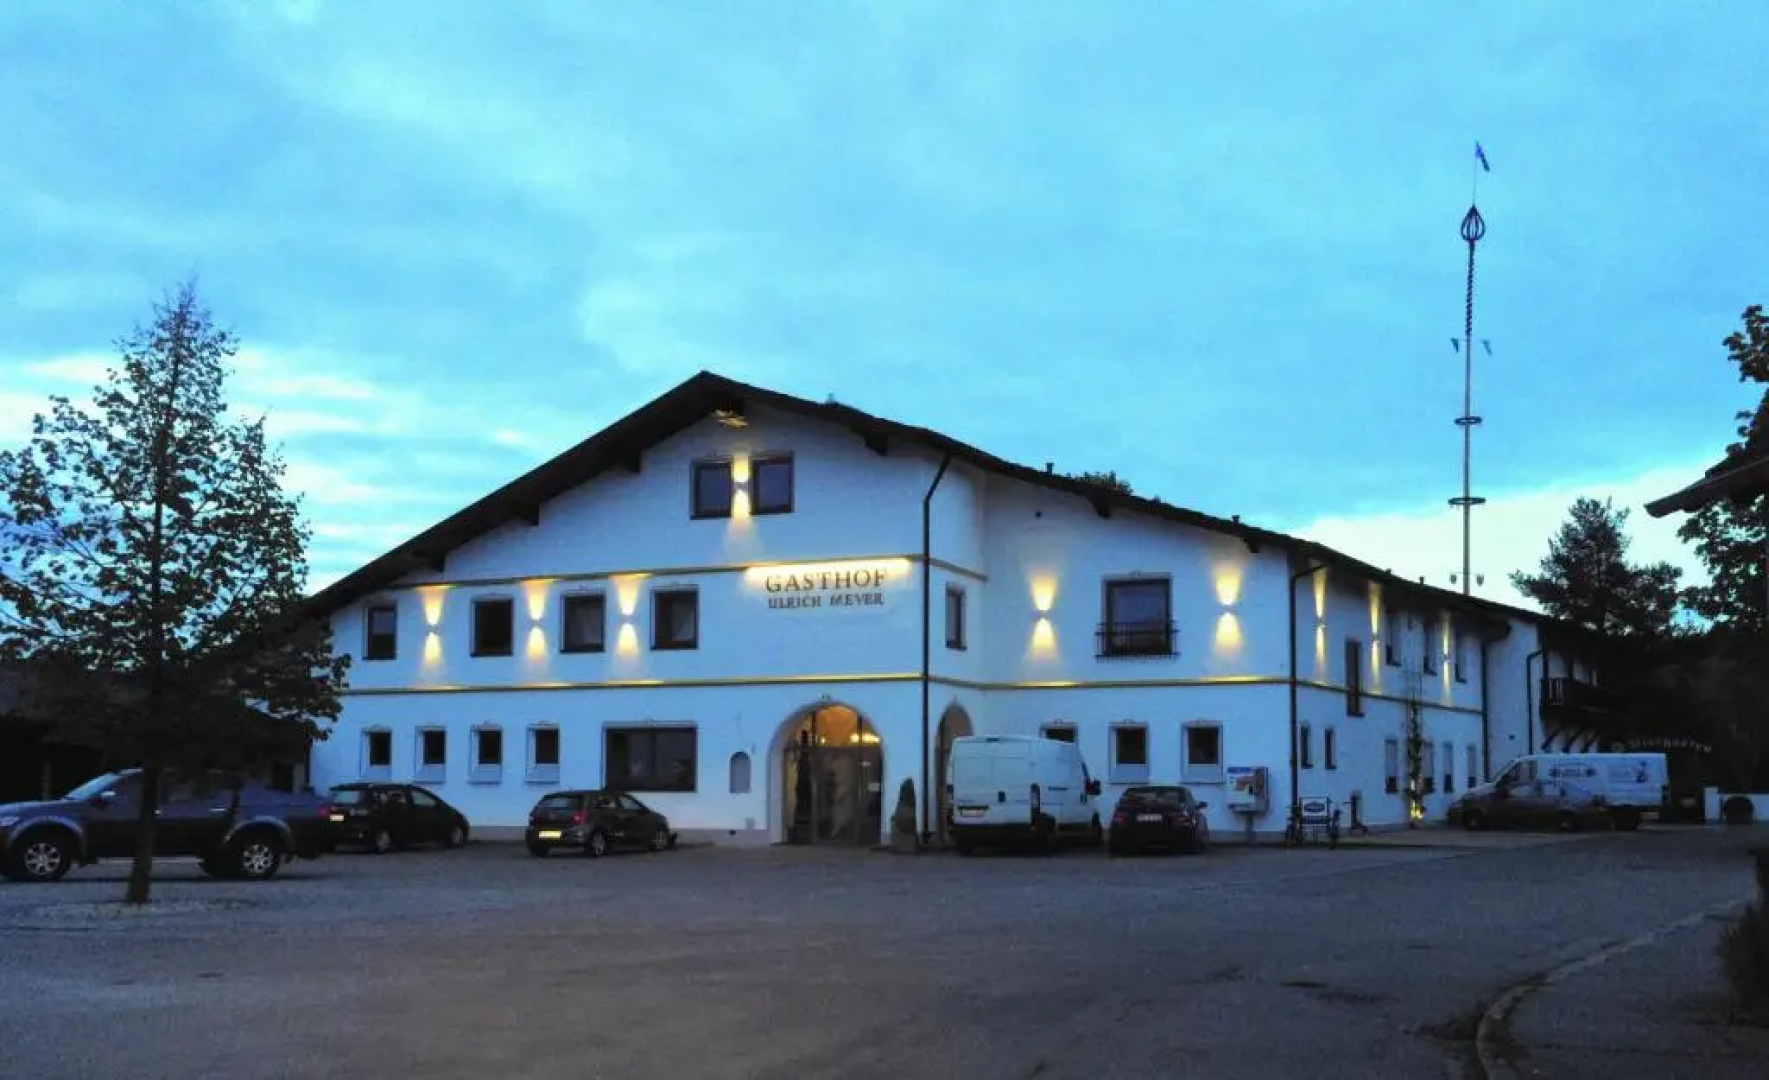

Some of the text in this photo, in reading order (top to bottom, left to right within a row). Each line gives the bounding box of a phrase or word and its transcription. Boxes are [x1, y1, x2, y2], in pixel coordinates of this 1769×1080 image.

[766, 568, 888, 593] GASTHOF
[768, 592, 885, 609] ULRICH MEYER
